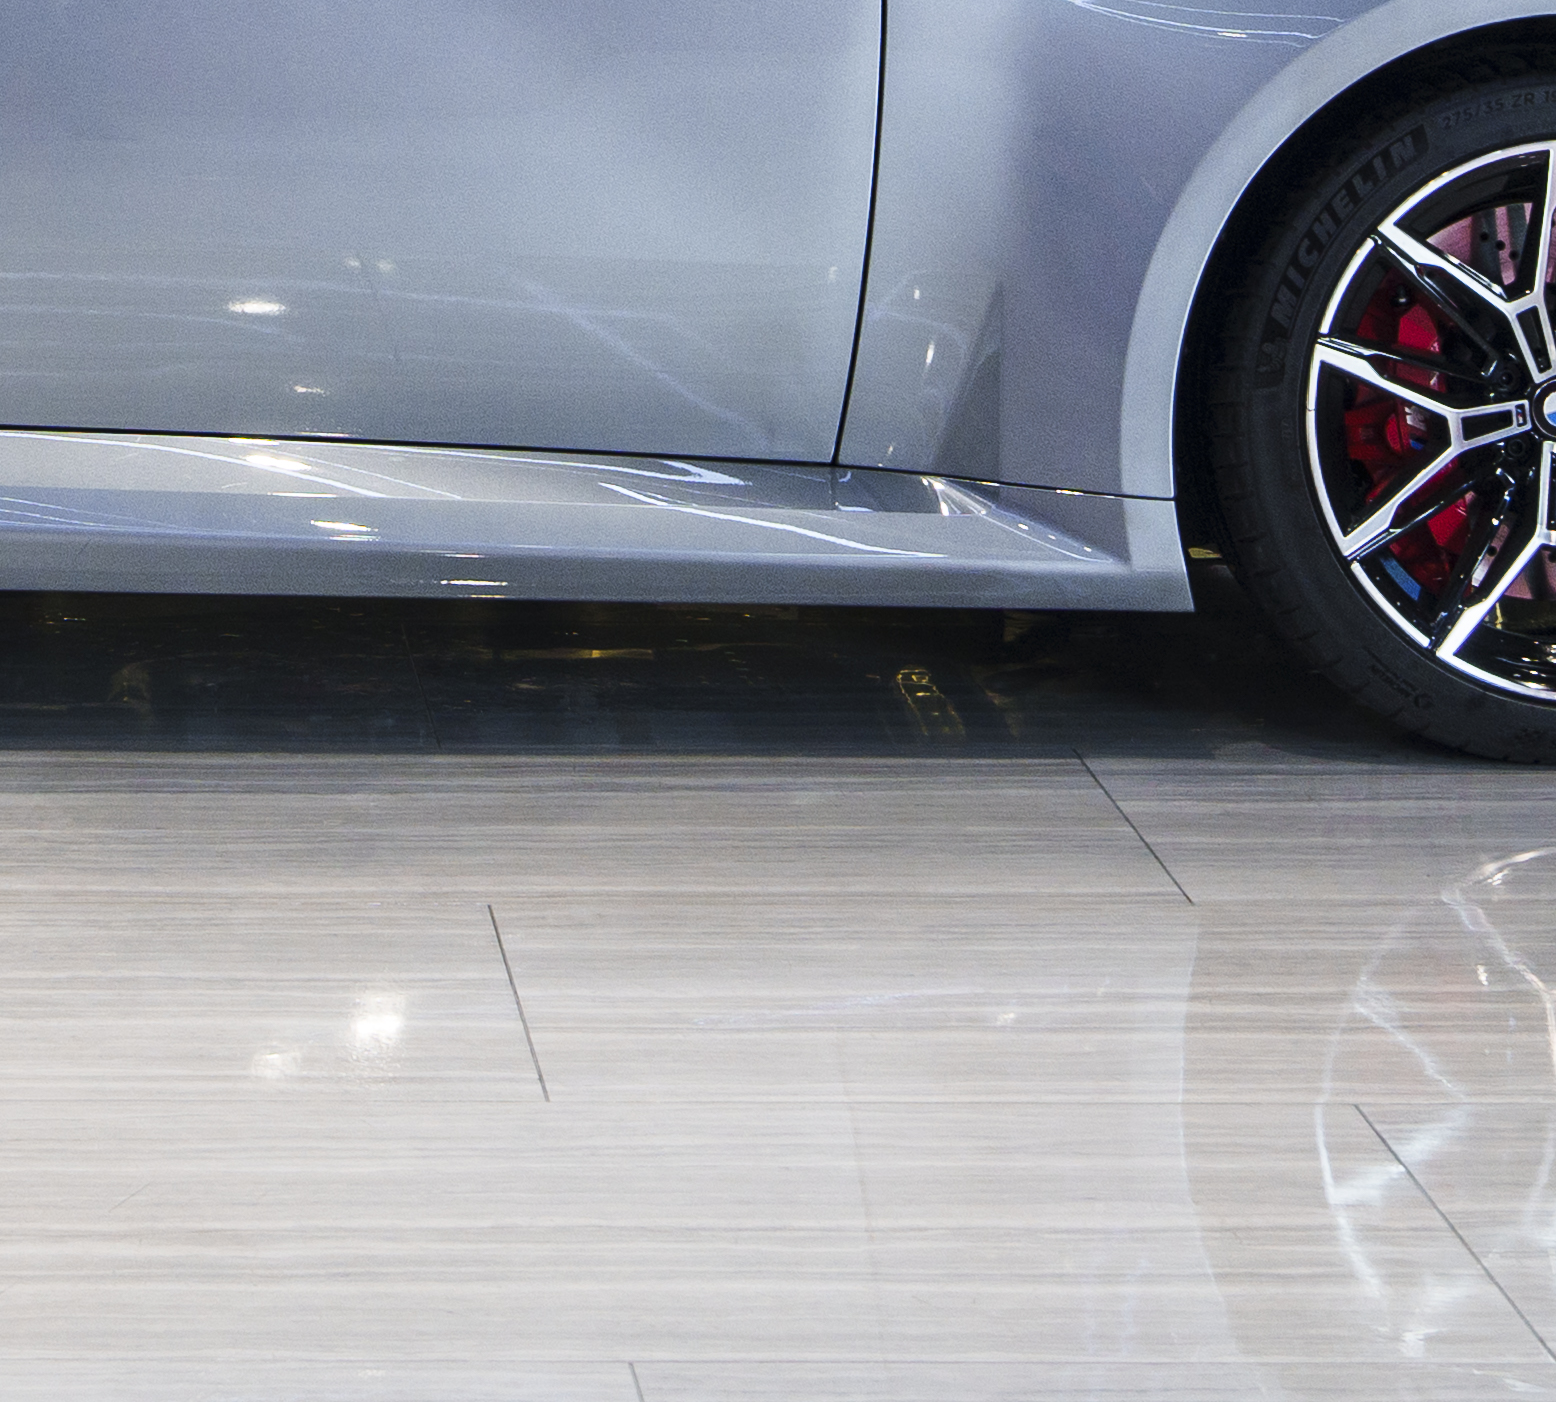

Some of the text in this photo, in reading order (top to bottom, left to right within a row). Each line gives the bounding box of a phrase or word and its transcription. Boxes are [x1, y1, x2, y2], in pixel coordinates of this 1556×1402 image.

[1271, 133, 1419, 327] MICHELIN
[1442, 98, 1504, 129] 275/35
[1509, 92, 1534, 108] ZR
